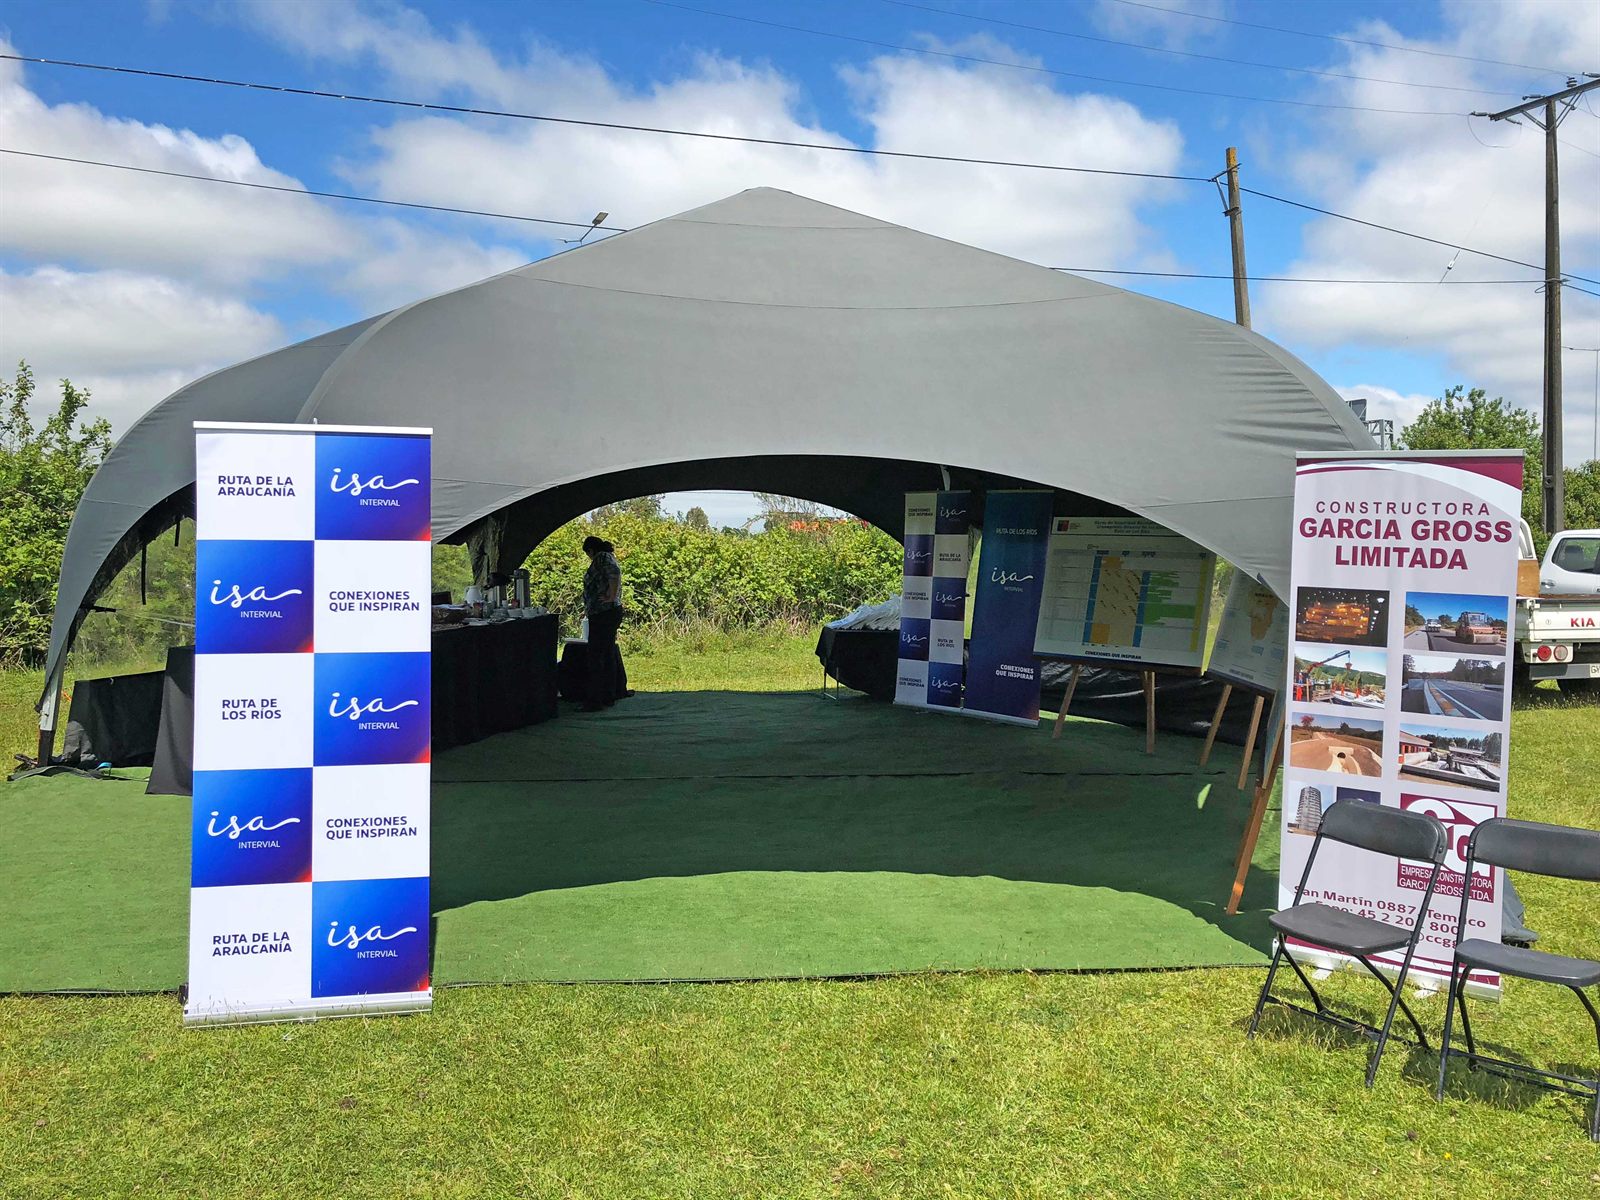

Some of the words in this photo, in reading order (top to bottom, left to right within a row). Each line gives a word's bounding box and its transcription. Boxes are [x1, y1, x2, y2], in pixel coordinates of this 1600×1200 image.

[218, 475, 252, 486] RUTA
[256, 475, 273, 486] DE
[277, 476, 294, 486] LA
[330, 468, 419, 496] isa
[217, 485, 296, 497] ARAUCANÍA
[359, 499, 401, 507] INTERVIAL
[1315, 501, 1490, 516] CONSTRUCTORA
[1299, 518, 1402, 541] GARCIA
[1410, 519, 1513, 543] GROSS
[1335, 545, 1469, 570] LIMITADA
[991, 567, 1034, 585] isa
[210, 579, 302, 608] isa
[329, 590, 410, 601] CONEXIONES
[329, 601, 356, 613] QUE
[359, 601, 420, 612] INSPIRAN
[240, 610, 283, 619] INTERVIAL
[1570, 617, 1596, 628] KIA
[995, 669, 1007, 677] QUE
[1007, 671, 1034, 681] INSPIRAN
[1000, 664, 1034, 674] CONEXIONES
[222, 699, 256, 709] RUTA
[260, 698, 278, 708] DE
[329, 692, 418, 720] isa
[221, 710, 247, 720] LOS
[251, 708, 282, 720] RÍOS
[358, 721, 400, 730] INTERVIAL
[207, 811, 300, 839] isa
[326, 816, 408, 828] CONEXIONES
[326, 829, 353, 840] QUE
[356, 827, 418, 839] INSPIRAN
[238, 840, 281, 849] INTERVIAL
[1433, 883, 1464, 897] GROSS
[1382, 912, 1390, 922] 2
[1427, 908, 1486, 928] Temco
[212, 934, 247, 945] RUTA
[252, 932, 270, 943] DE
[273, 931, 290, 941] LA
[327, 921, 417, 949] isa
[212, 941, 292, 957] ARAUCANÍA
[357, 950, 398, 959] INTERVIAL
